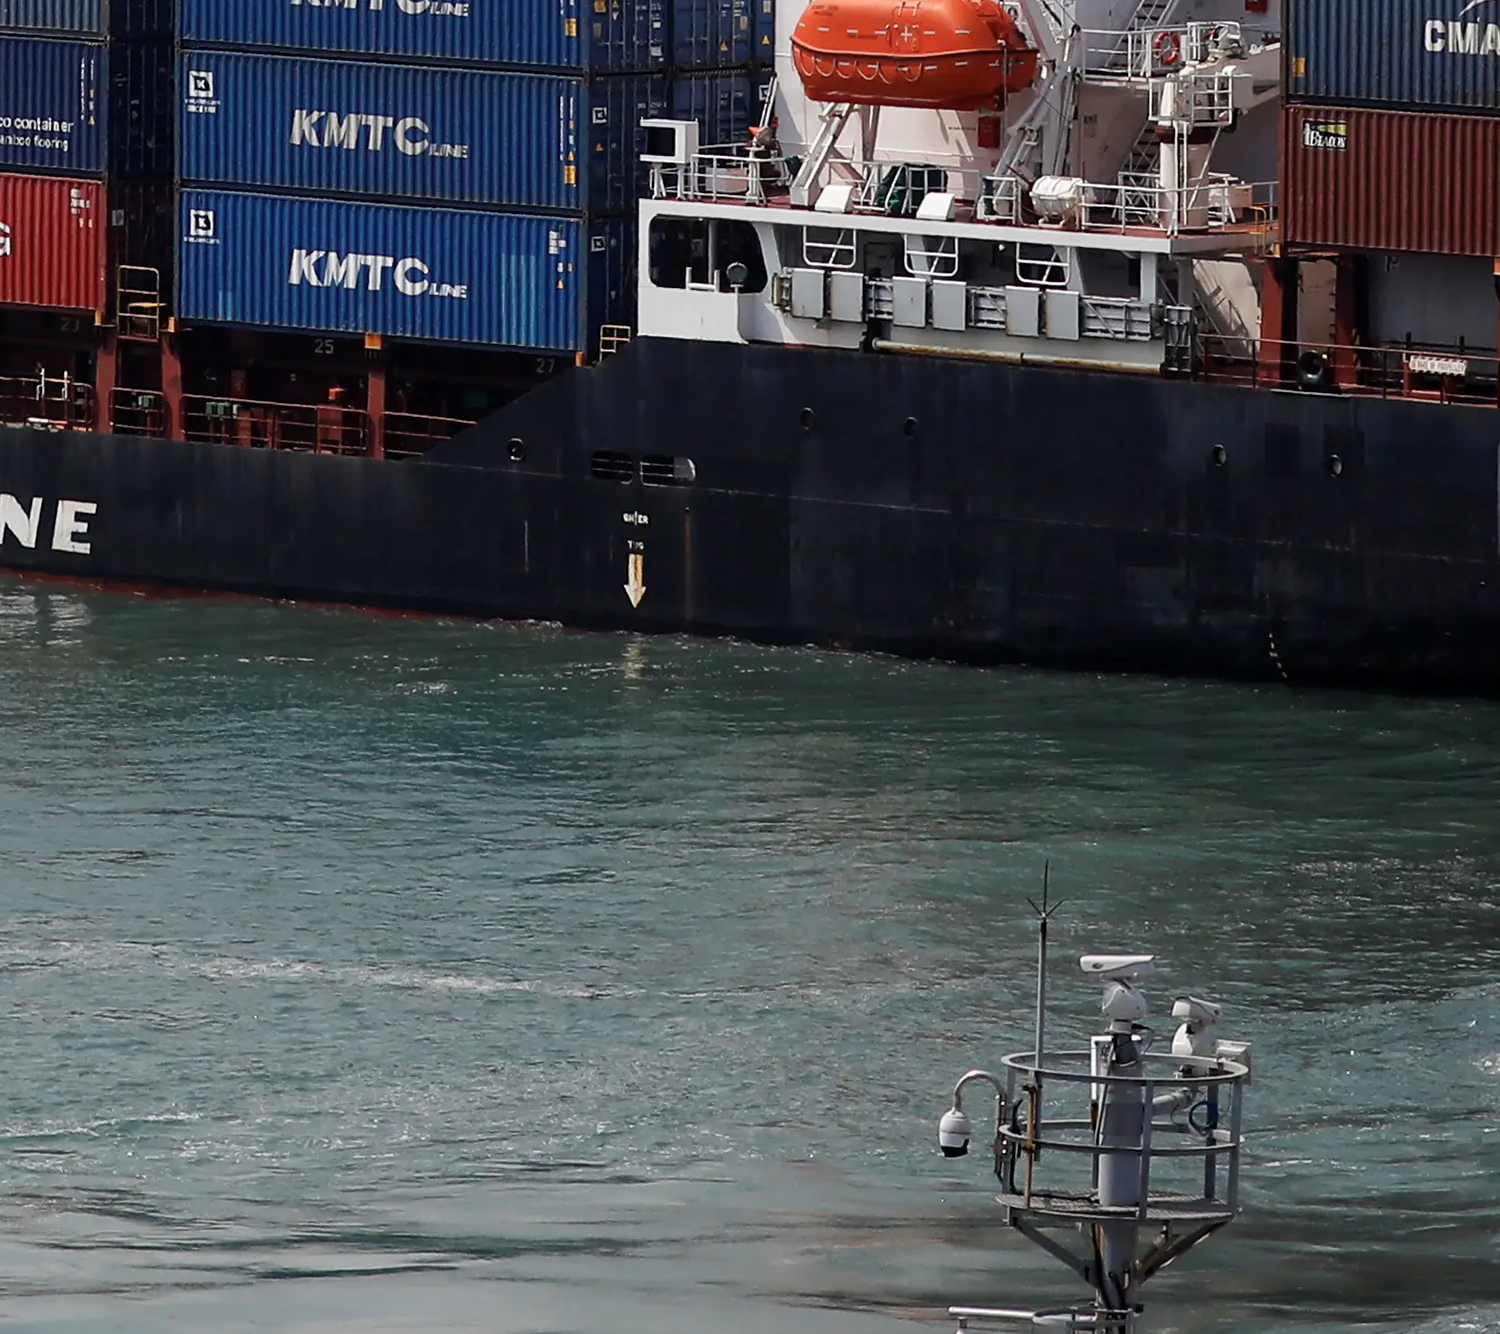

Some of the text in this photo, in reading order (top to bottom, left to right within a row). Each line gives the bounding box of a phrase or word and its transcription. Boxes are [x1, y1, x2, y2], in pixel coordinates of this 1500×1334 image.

[430, 0, 470, 18] LINE
[13, 115, 74, 134] container
[289, 108, 469, 159] KMTC LINE
[33, 135, 69, 152] flooring
[288, 248, 468, 299] KMTC LINE
[314, 339, 334, 355] 25
[536, 358, 555, 373] 27
